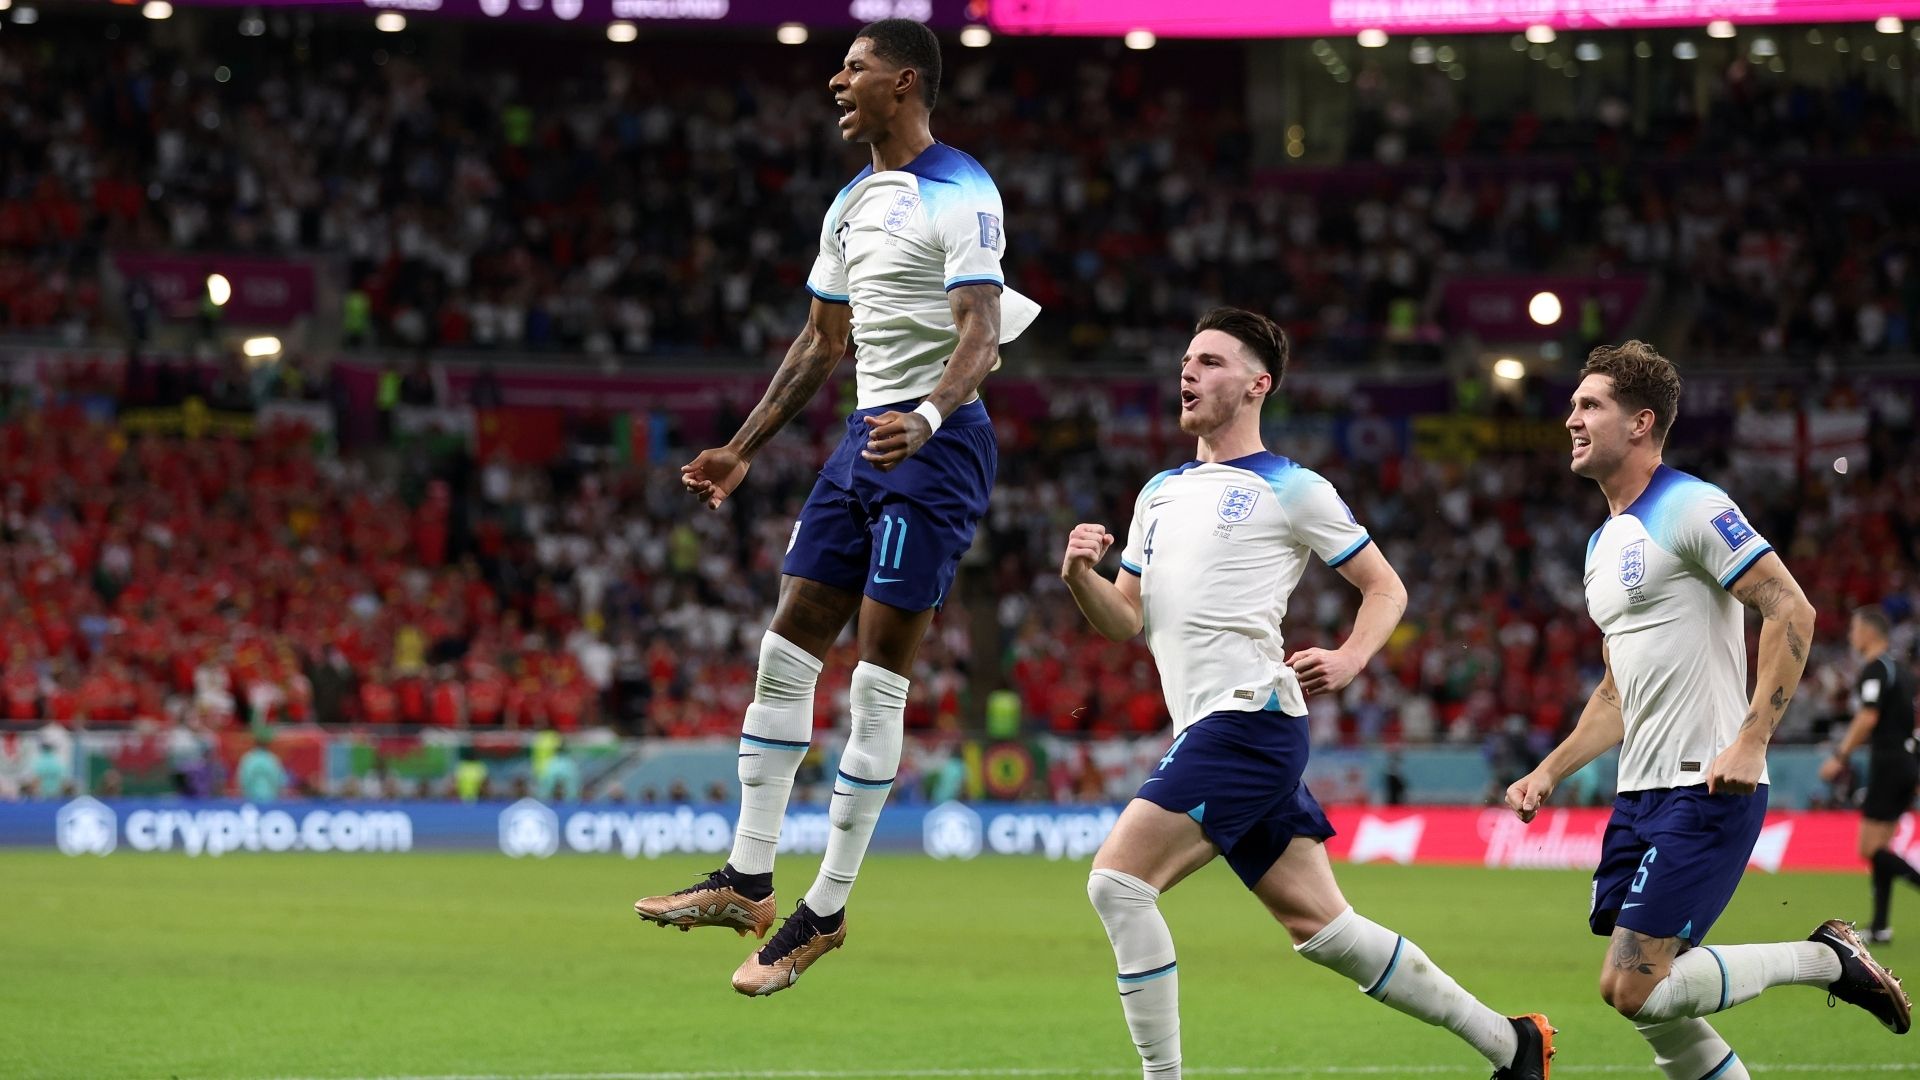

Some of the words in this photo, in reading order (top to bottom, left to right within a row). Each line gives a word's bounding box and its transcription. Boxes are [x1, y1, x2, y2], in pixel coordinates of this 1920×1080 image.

[879, 514, 908, 569] 11
[1143, 518, 1158, 565] 4
[1158, 731, 1188, 771] 4
[125, 803, 413, 857] crypto.com
[565, 806, 830, 859] crypto.om
